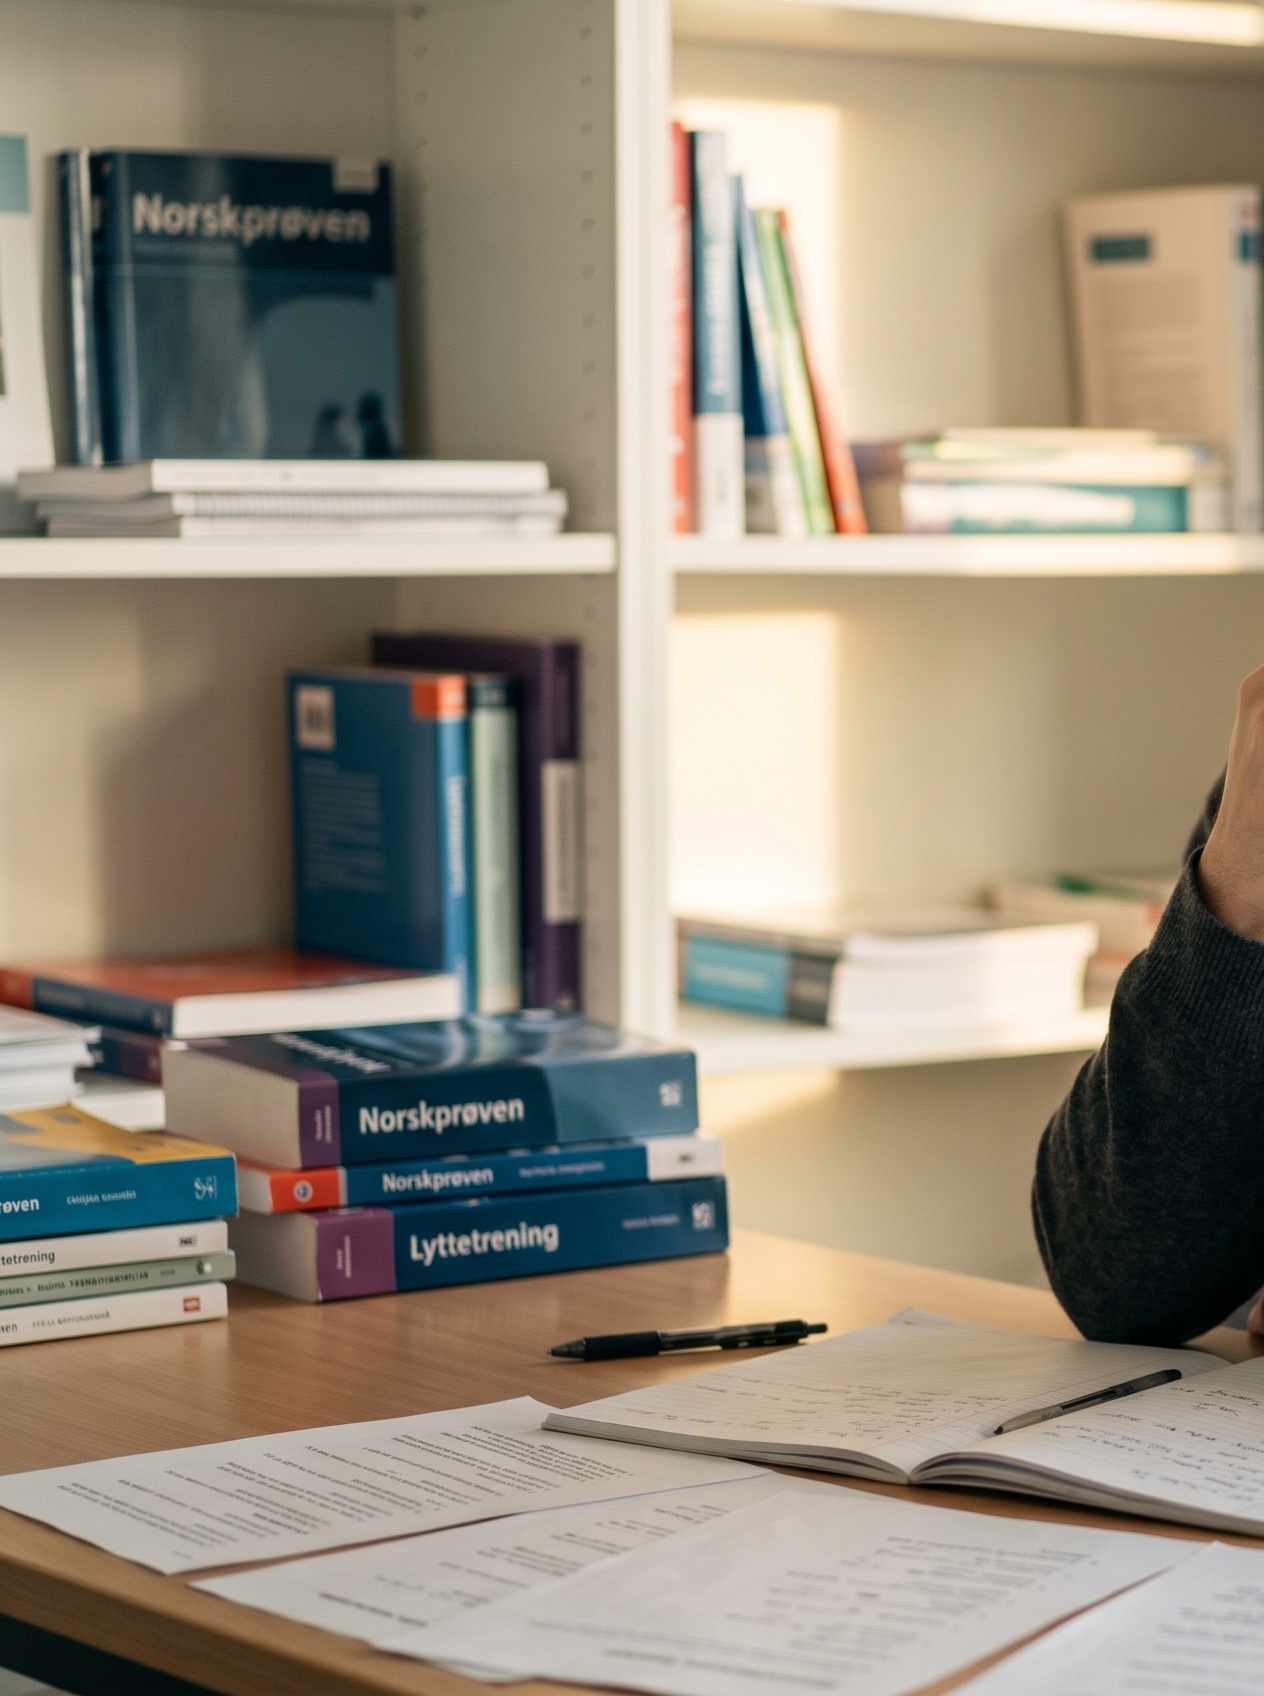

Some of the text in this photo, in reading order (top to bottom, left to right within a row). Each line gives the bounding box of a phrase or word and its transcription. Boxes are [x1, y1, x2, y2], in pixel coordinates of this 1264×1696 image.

[359, 1098, 525, 1134] Norskprøven
[382, 1168, 494, 1192] Norskprøven
[1, 1250, 55, 1265] tetrening
[410, 1221, 559, 1266] Lyttetrening
